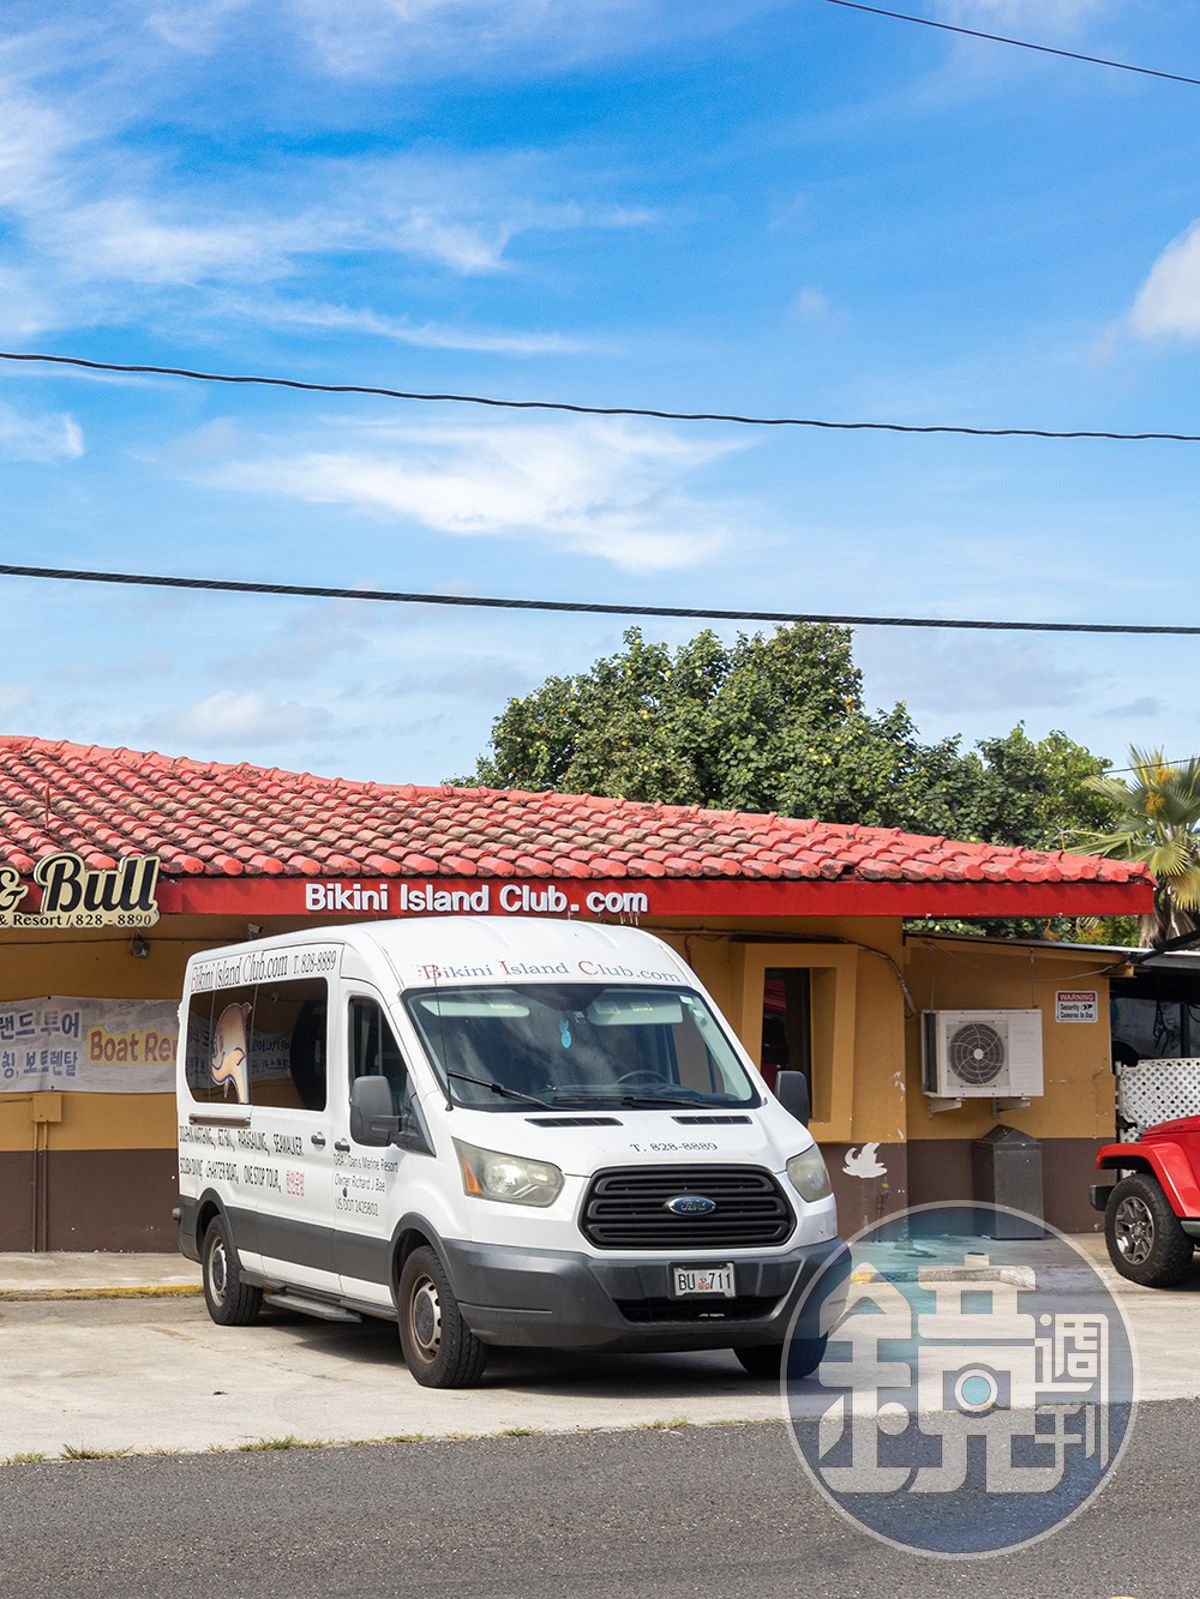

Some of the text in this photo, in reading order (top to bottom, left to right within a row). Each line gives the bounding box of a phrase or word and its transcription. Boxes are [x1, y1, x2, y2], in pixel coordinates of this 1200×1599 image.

[39, 854, 157, 912] Bull
[305, 883, 388, 911] Bikini
[400, 884, 489, 912] Island
[586, 892, 648, 913] com
[12, 913, 62, 926] Resort
[75, 914, 103, 926] 828
[117, 914, 152, 926] 8890
[191, 964, 215, 992] Bikini
[215, 957, 242, 988] Island
[243, 952, 289, 983] Club.com
[421, 960, 681, 983] Bikini Island Club.com
[1060, 993, 1094, 1001] WARNING
[1060, 1003, 1080, 1012] Security
[40, 1011, 80, 1038] 투어
[89, 1029, 139, 1062] Boat
[649, 1142, 719, 1152] 828-8889
[681, 1199, 706, 1212] Ford
[678, 1272, 731, 1291] BU 711
